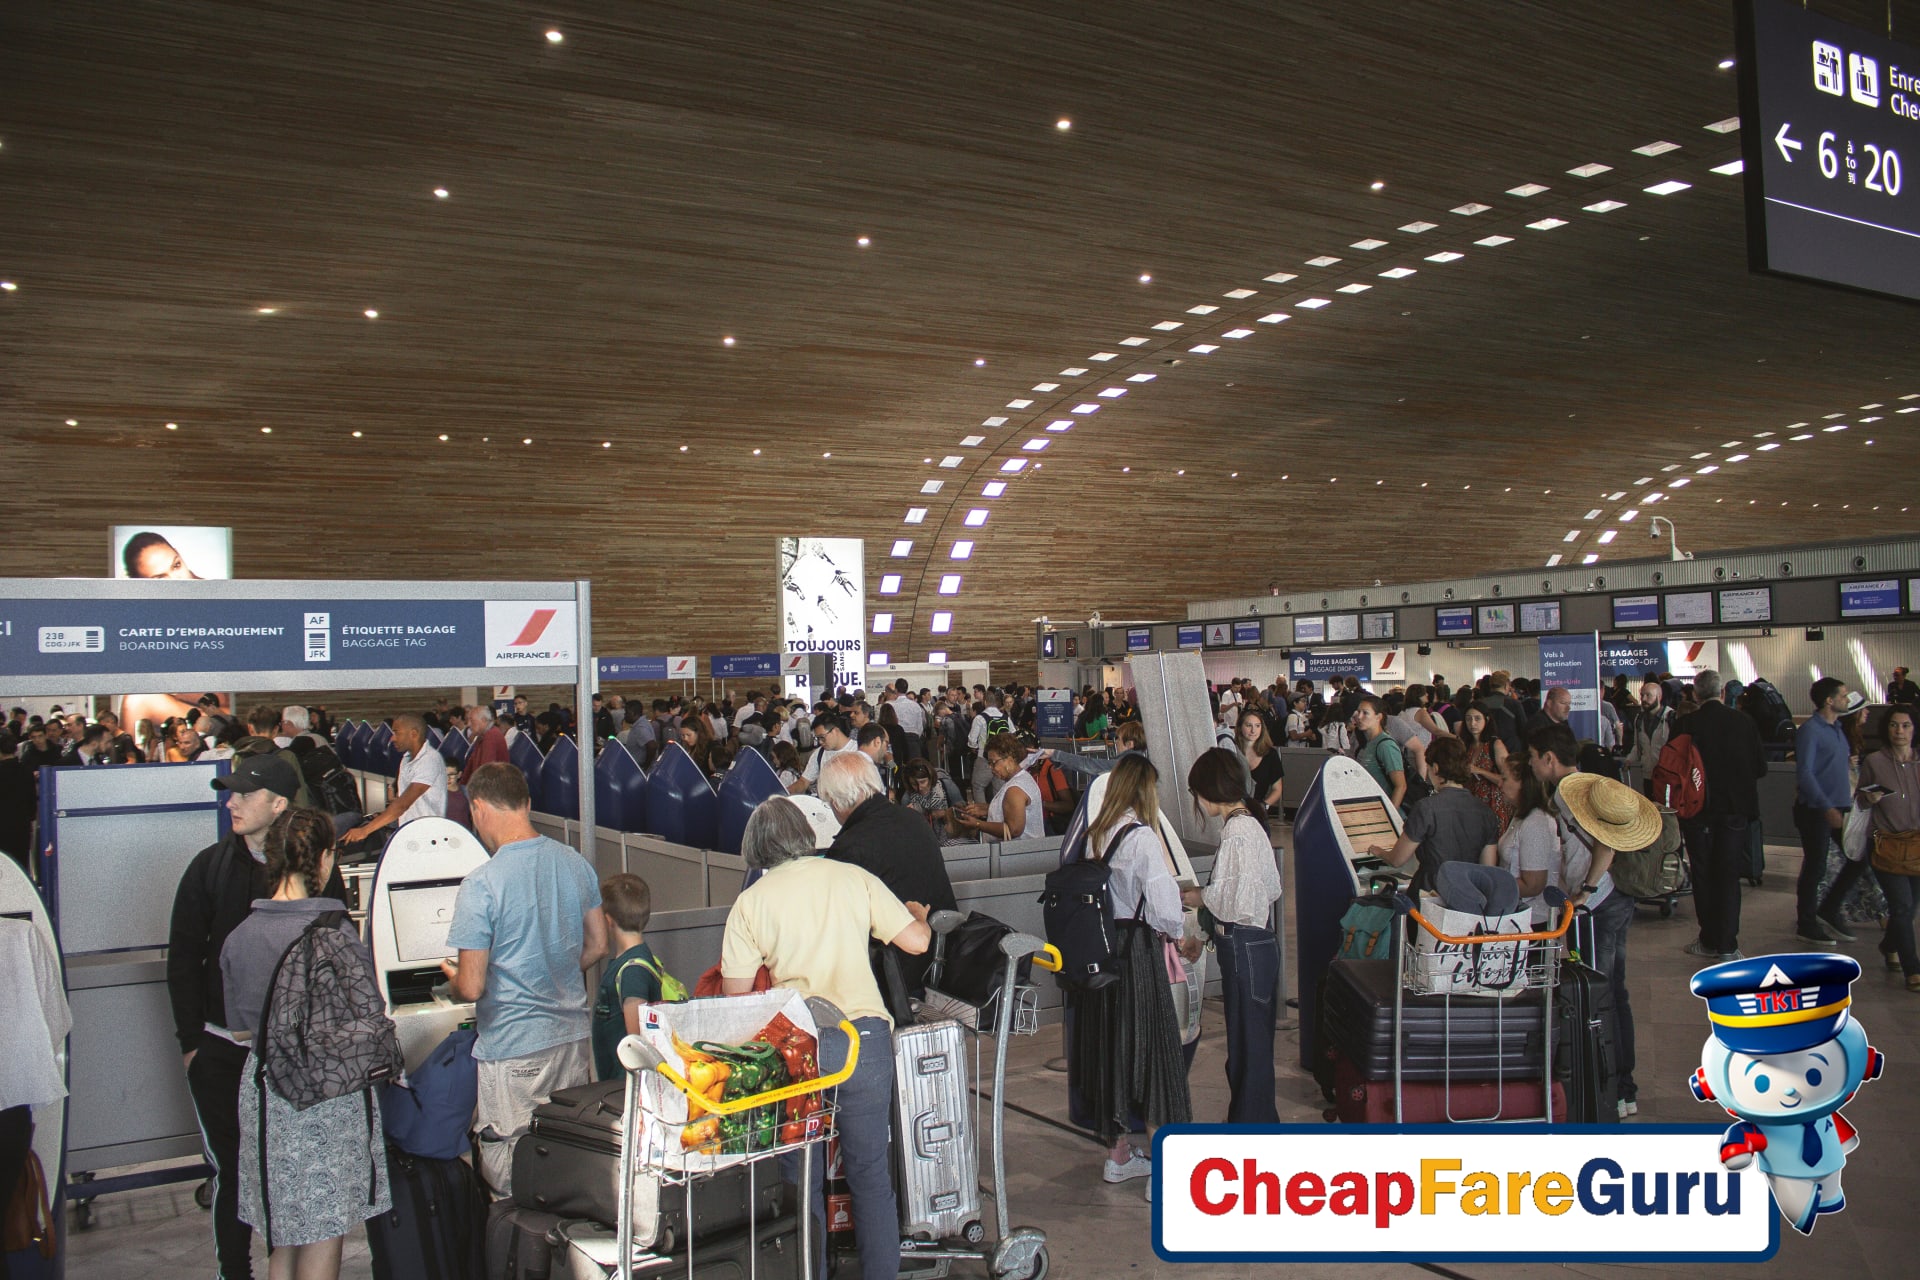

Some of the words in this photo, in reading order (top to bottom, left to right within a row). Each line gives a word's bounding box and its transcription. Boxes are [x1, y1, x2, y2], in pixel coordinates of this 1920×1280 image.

[1818, 131, 1838, 179] 6
[1864, 144, 1902, 196] 20
[1845, 156, 1856, 169] to
[119, 628, 163, 637] CARTE
[166, 627, 285, 637] D'EMBARQUEMENT
[342, 625, 404, 635] ÉTIQUETTE
[407, 625, 456, 634] BAGAGE
[119, 641, 190, 651] BOARDING
[193, 640, 225, 650] PASS
[342, 639, 400, 648] BAGGAGE
[404, 638, 427, 647] TAG
[788, 639, 861, 652] TOUJOURS
[1045, 639, 1052, 653] 4
[309, 650, 326, 658] JFK
[496, 651, 551, 660] AIRFRANCE
[1610, 649, 1648, 657] BAGAGES
[1544, 660, 1582, 668] destination
[1619, 658, 1659, 666] DROP-OFF
